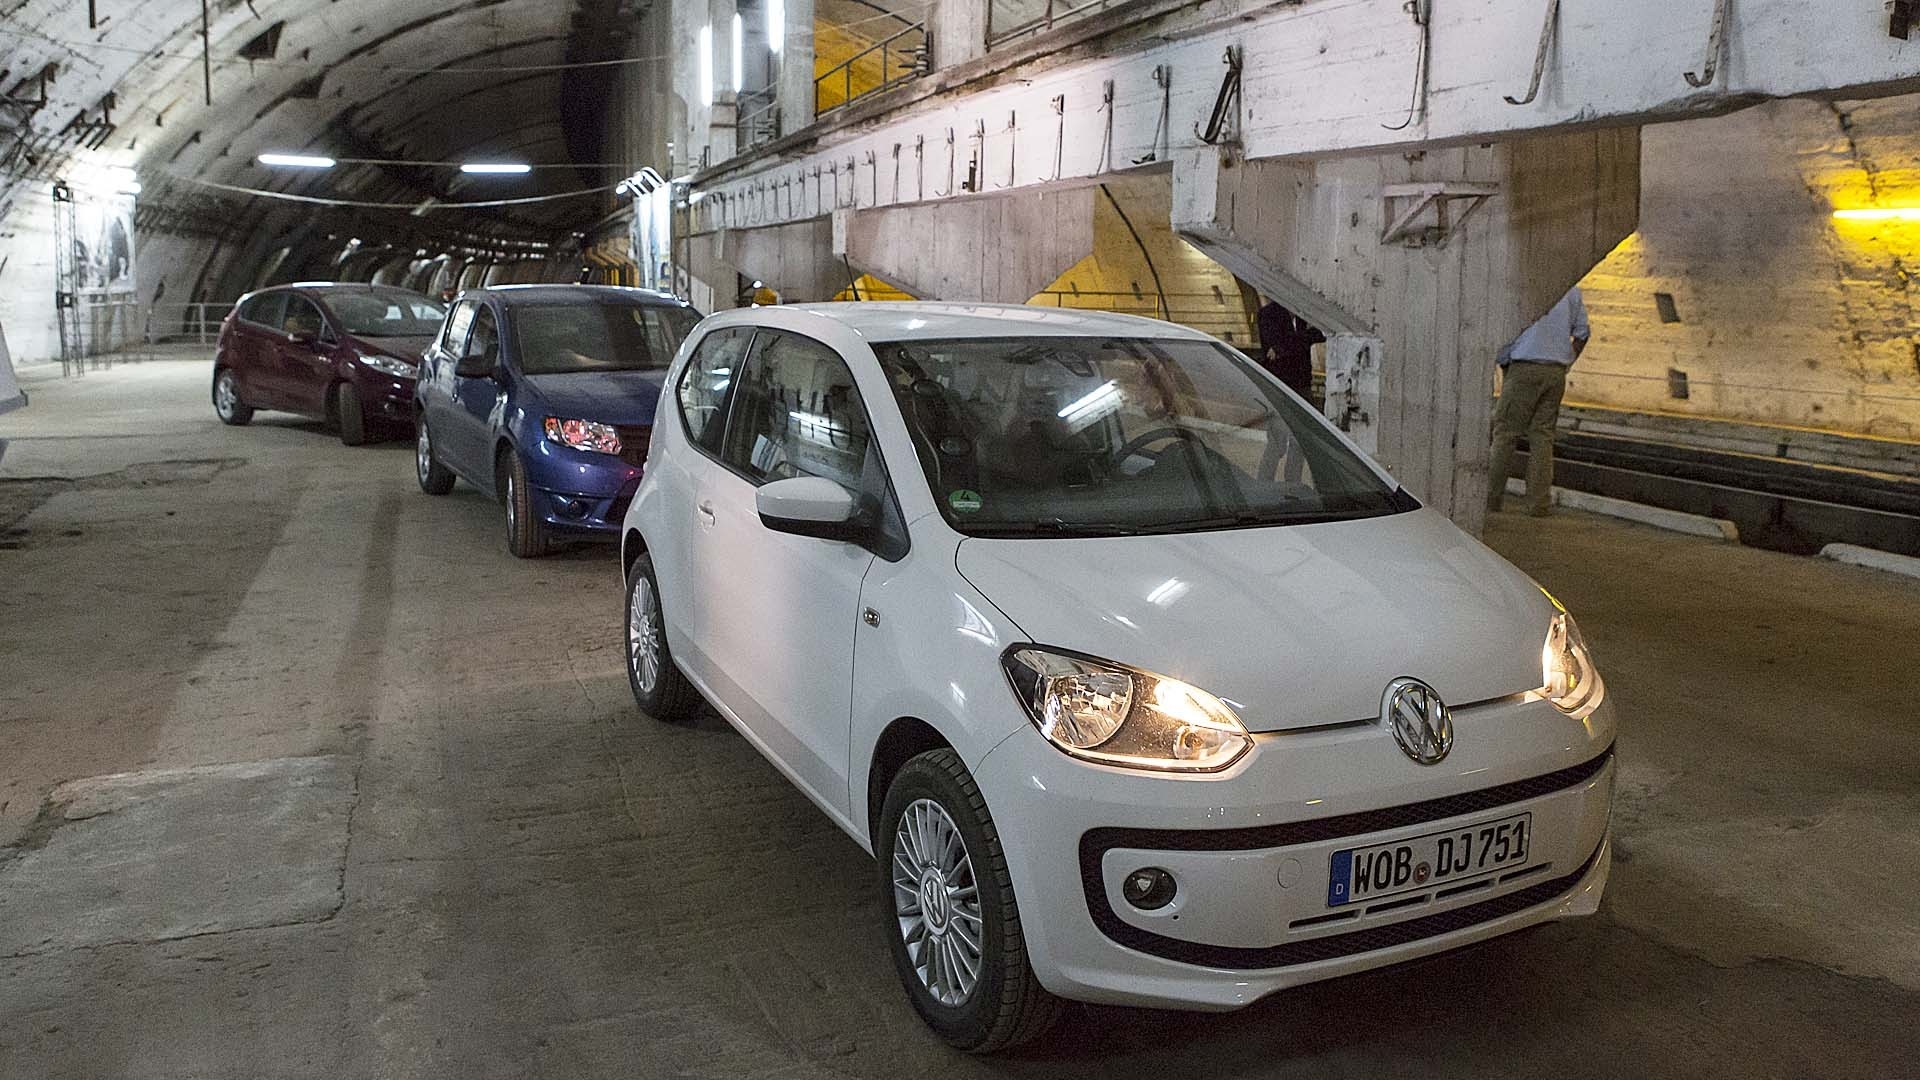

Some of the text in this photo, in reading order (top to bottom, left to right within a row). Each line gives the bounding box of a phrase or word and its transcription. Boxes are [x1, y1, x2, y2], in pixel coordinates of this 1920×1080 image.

[960, 490, 970, 501] 4
[1335, 821, 1525, 895] D WOB DJ 751
